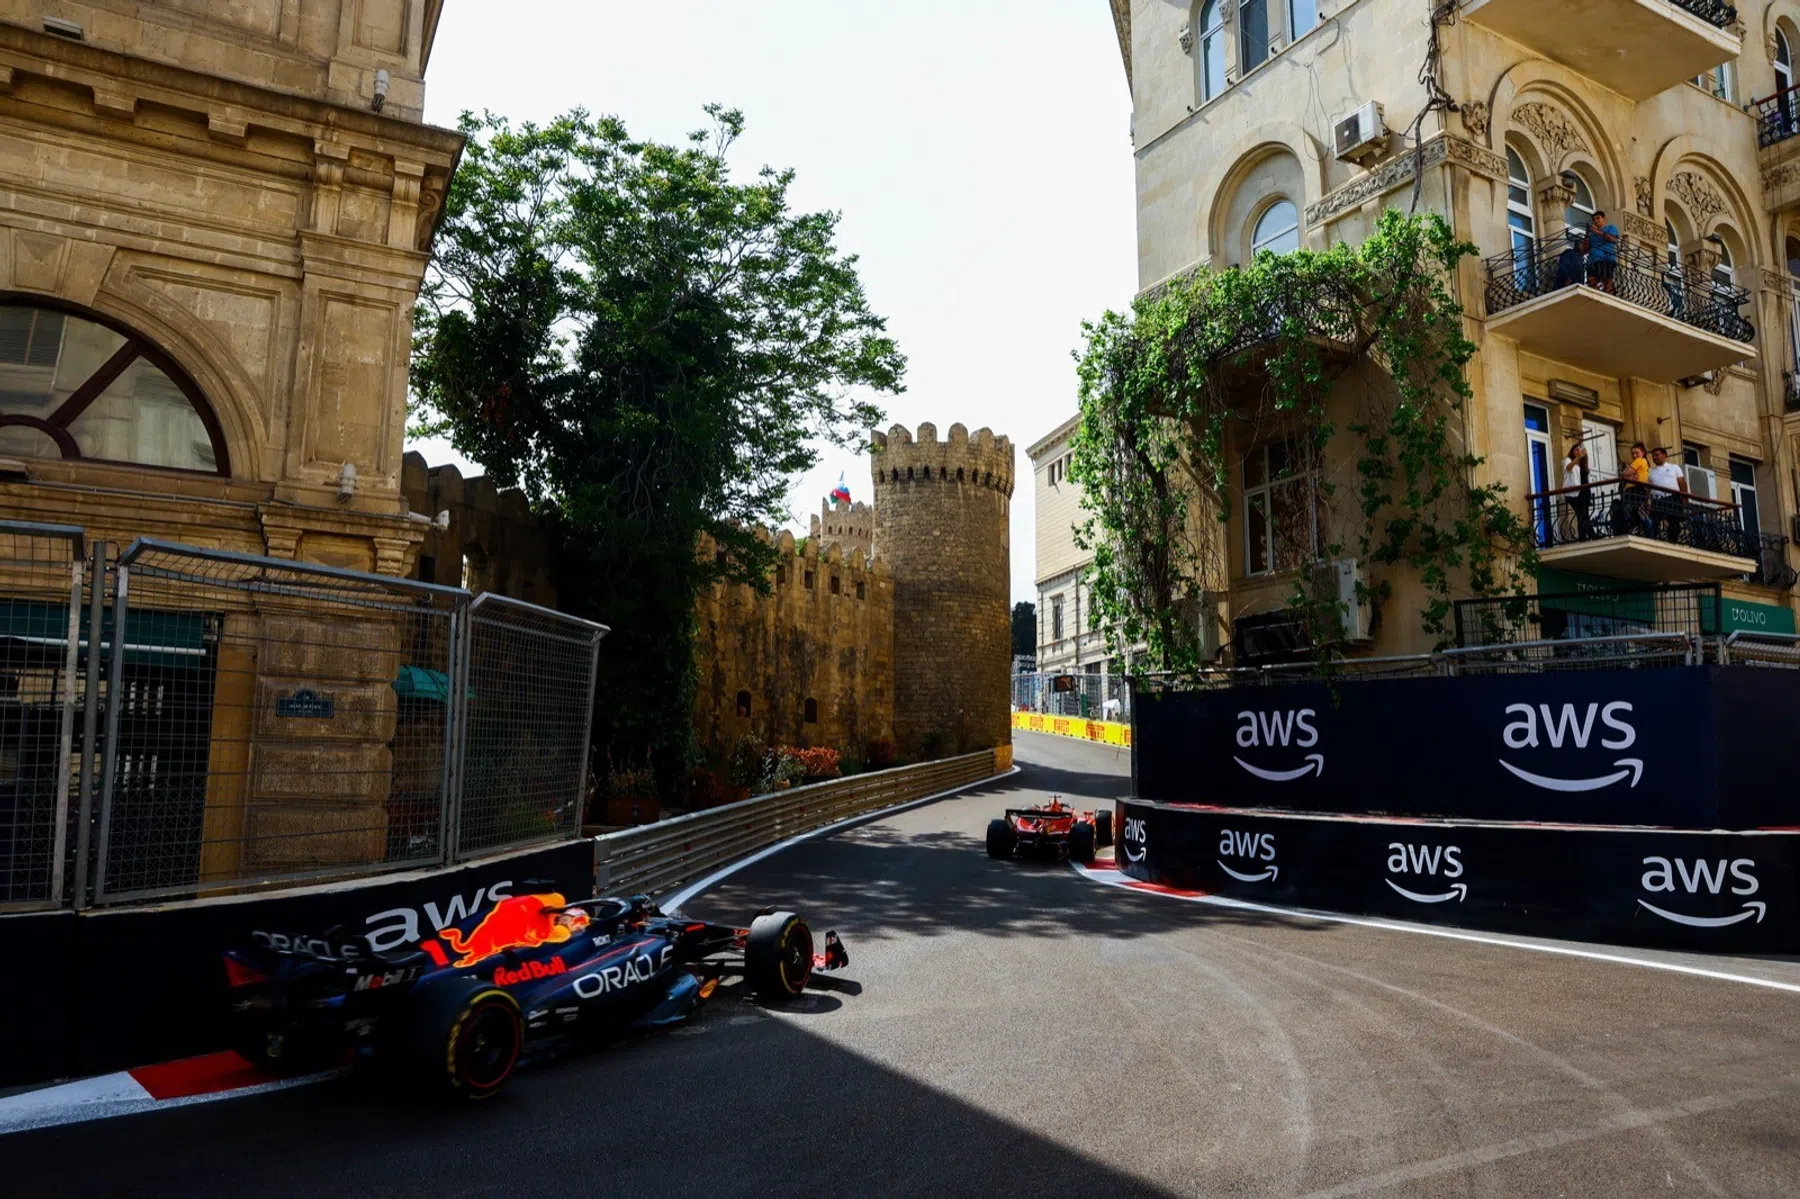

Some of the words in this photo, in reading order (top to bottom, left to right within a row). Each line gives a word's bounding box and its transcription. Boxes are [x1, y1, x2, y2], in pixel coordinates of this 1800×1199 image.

[1236, 708, 1319, 748] aws
[1502, 700, 1637, 750] aws
[1124, 817, 1147, 844] aws
[1219, 829, 1276, 861] aws
[1387, 842, 1464, 878] aws
[1641, 856, 1760, 896] aws
[364, 880, 513, 952] aws
[251, 929, 361, 962] ORACLE
[419, 939, 452, 969] 1
[353, 969, 403, 993] Mobil
[572, 943, 674, 1000] ORACLE
